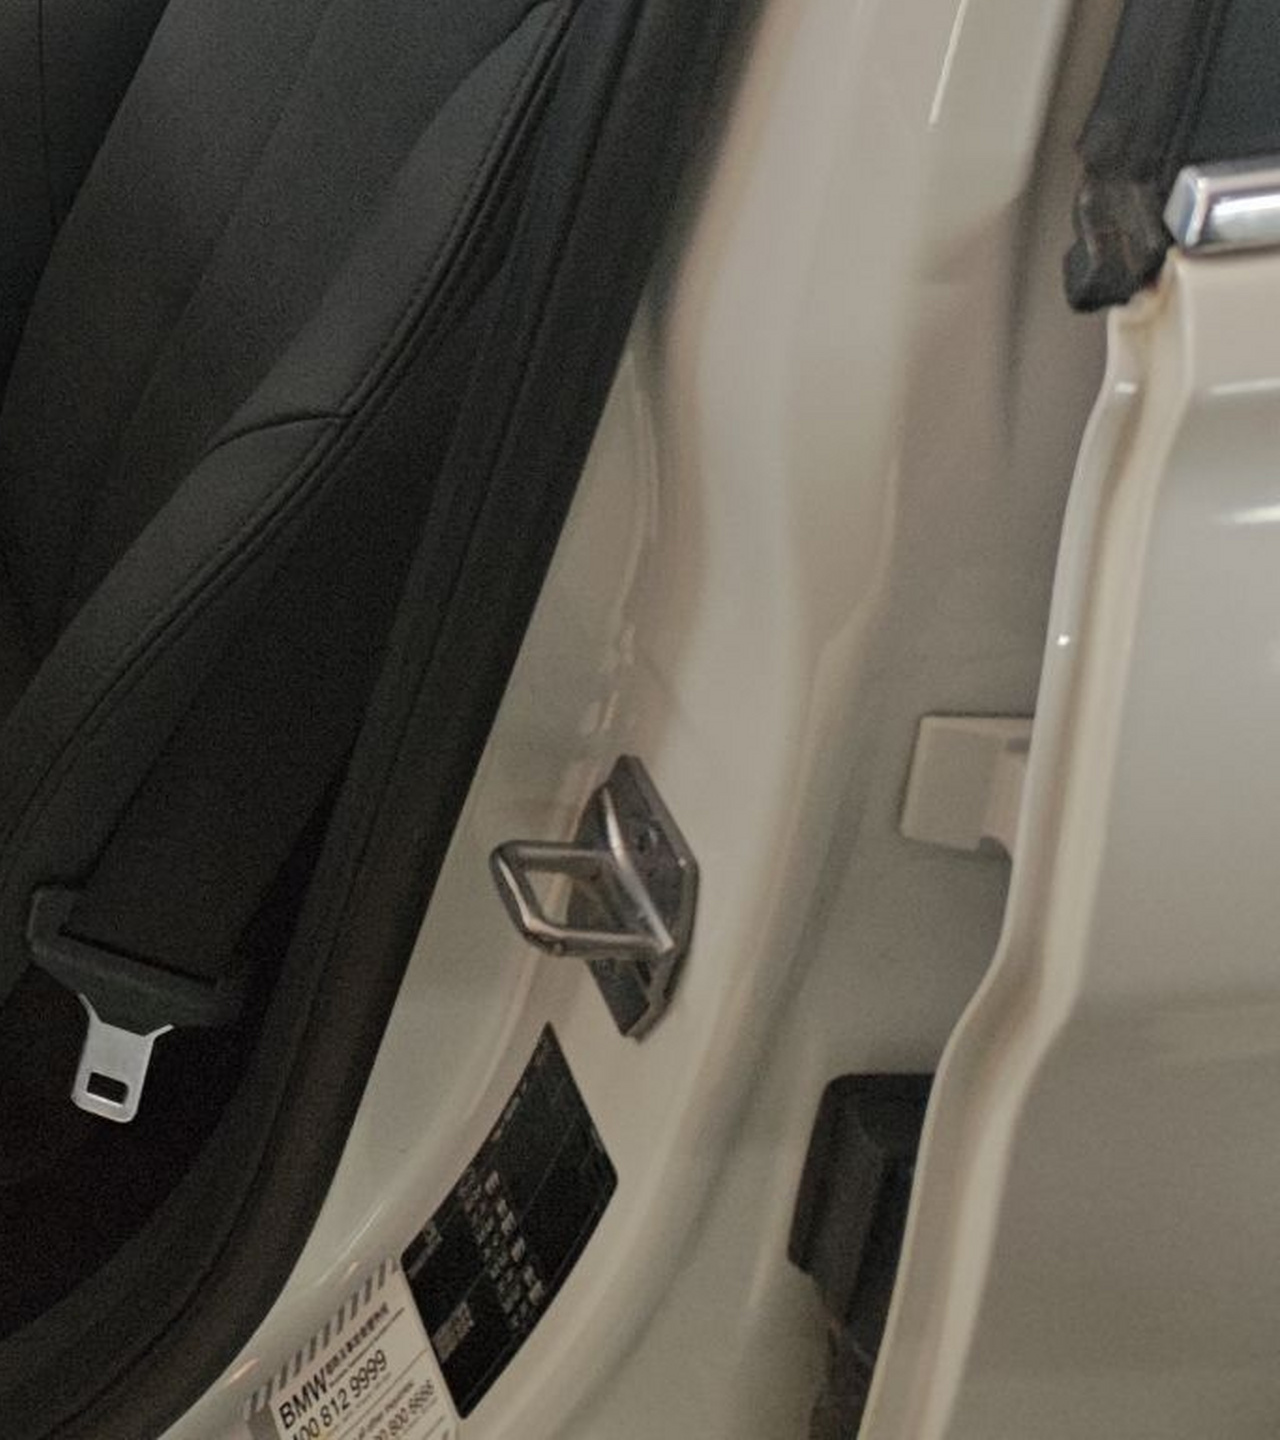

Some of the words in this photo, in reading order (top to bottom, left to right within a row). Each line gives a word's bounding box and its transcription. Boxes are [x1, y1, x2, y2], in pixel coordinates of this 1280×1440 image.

[279, 1367, 327, 1430] BMW
[320, 1388, 350, 1427] 812
[350, 1349, 388, 1398] 9999
